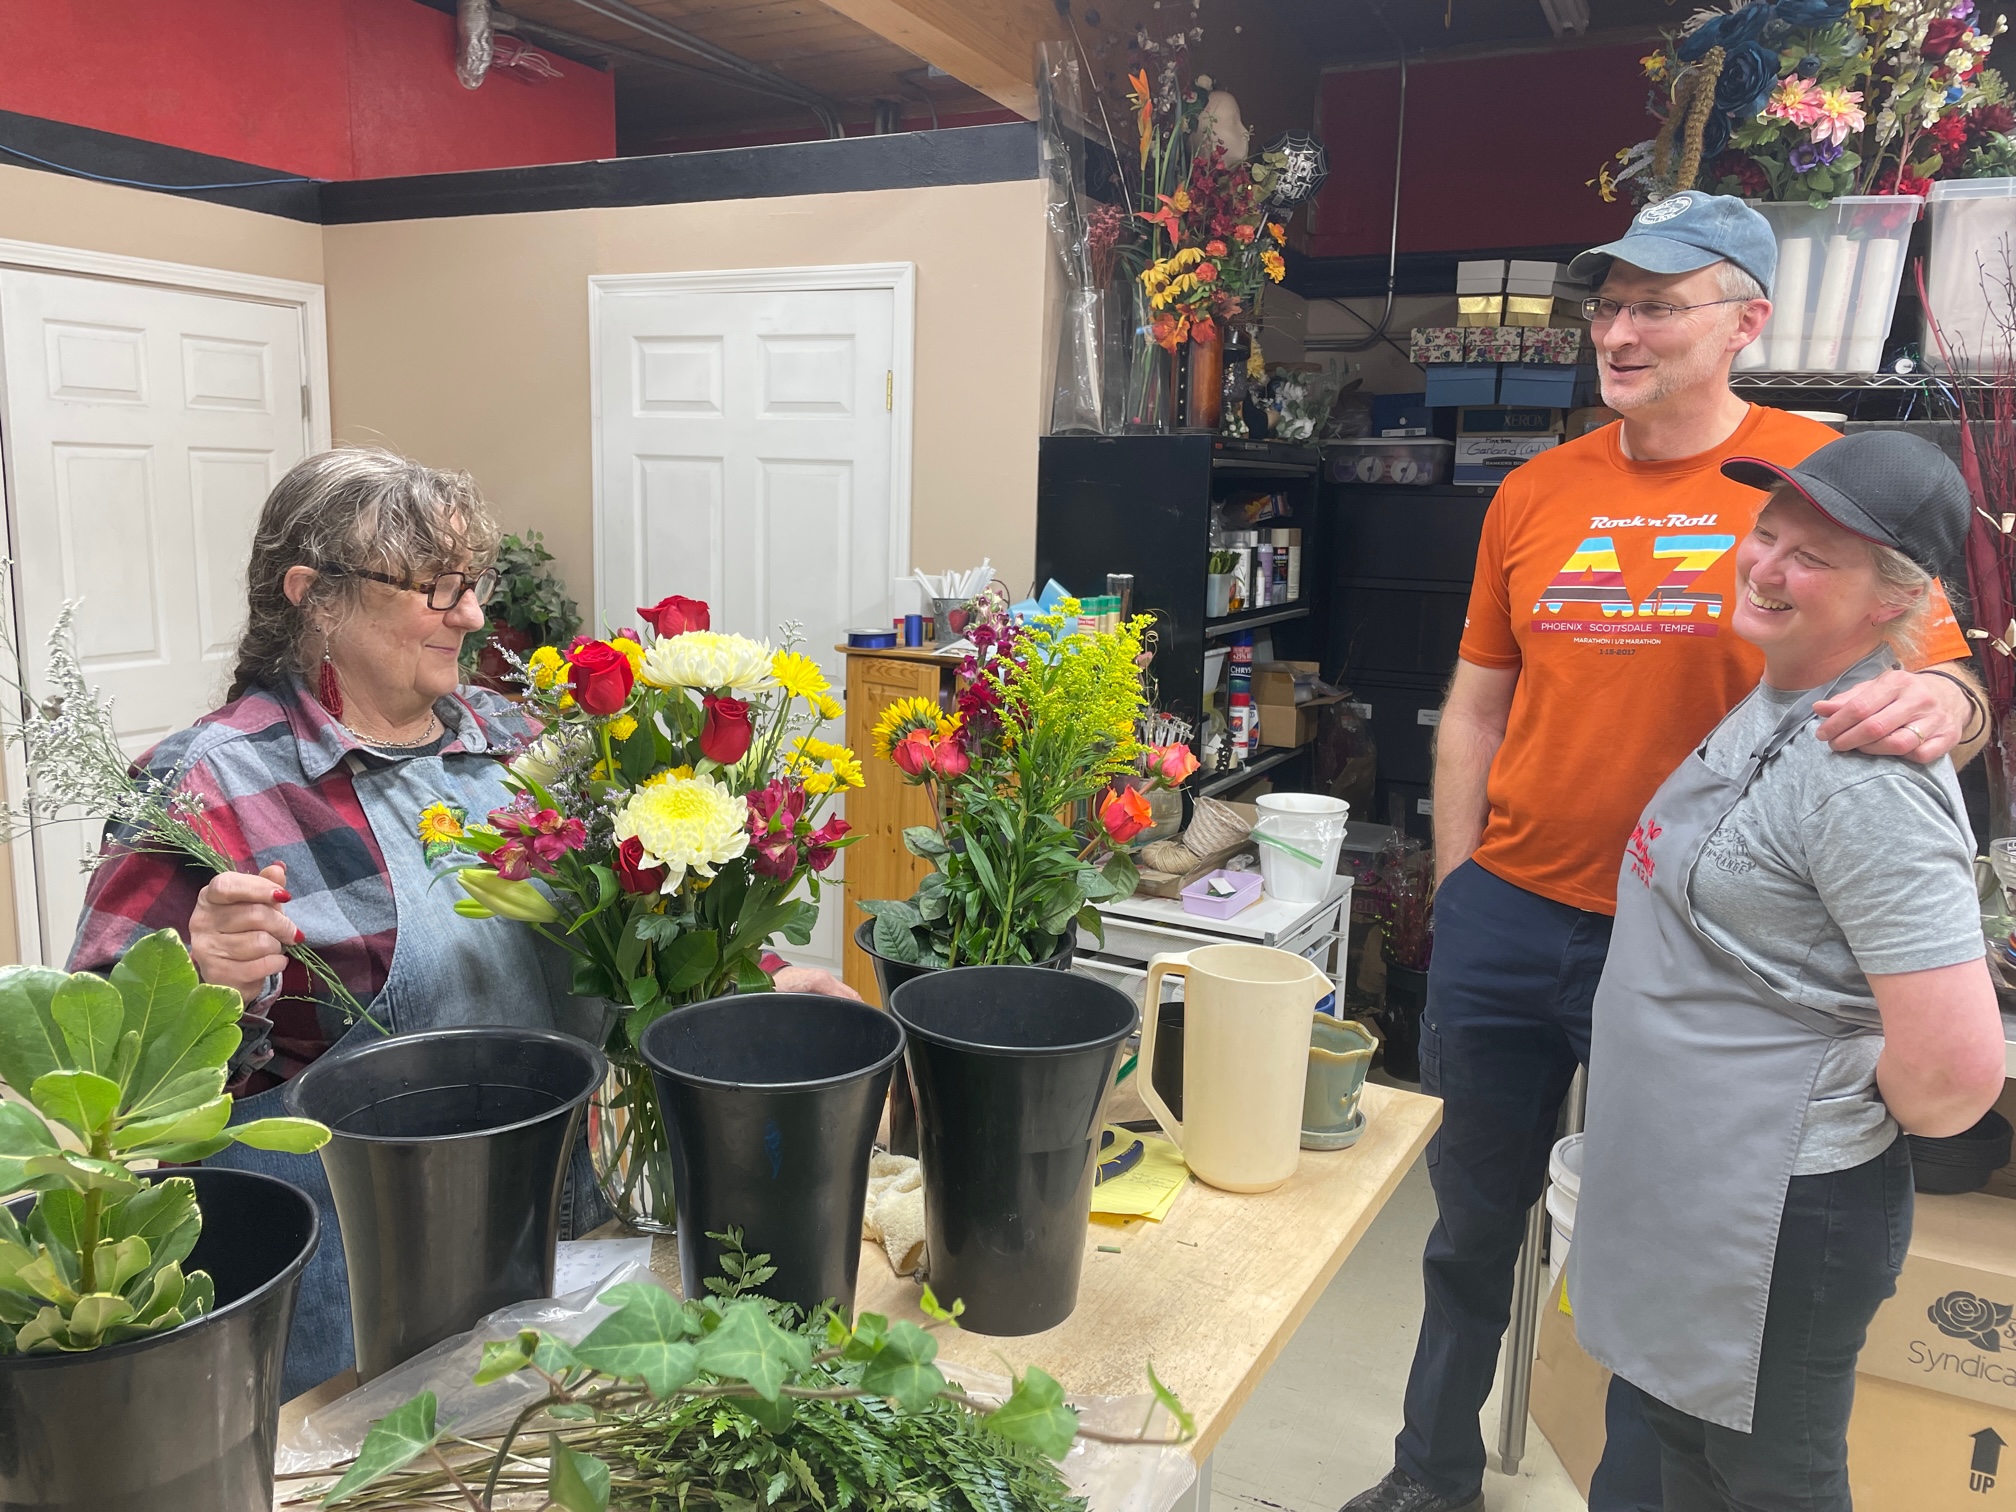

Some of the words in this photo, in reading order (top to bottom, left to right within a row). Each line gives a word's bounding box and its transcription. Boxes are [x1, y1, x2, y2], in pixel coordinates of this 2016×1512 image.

[1503, 414, 1545, 427] XEROX
[1467, 442, 1519, 456] Garland
[1532, 534, 1737, 619] AZ
[1541, 622, 1583, 631] PHOENIX
[1589, 623, 1652, 633] SCOTTSDALE
[1659, 623, 1695, 634] TEMPE
[1573, 637, 1611, 645] MARATHON
[1715, 853, 1747, 875] RANGE
[1969, 1472, 1995, 1495] UP
